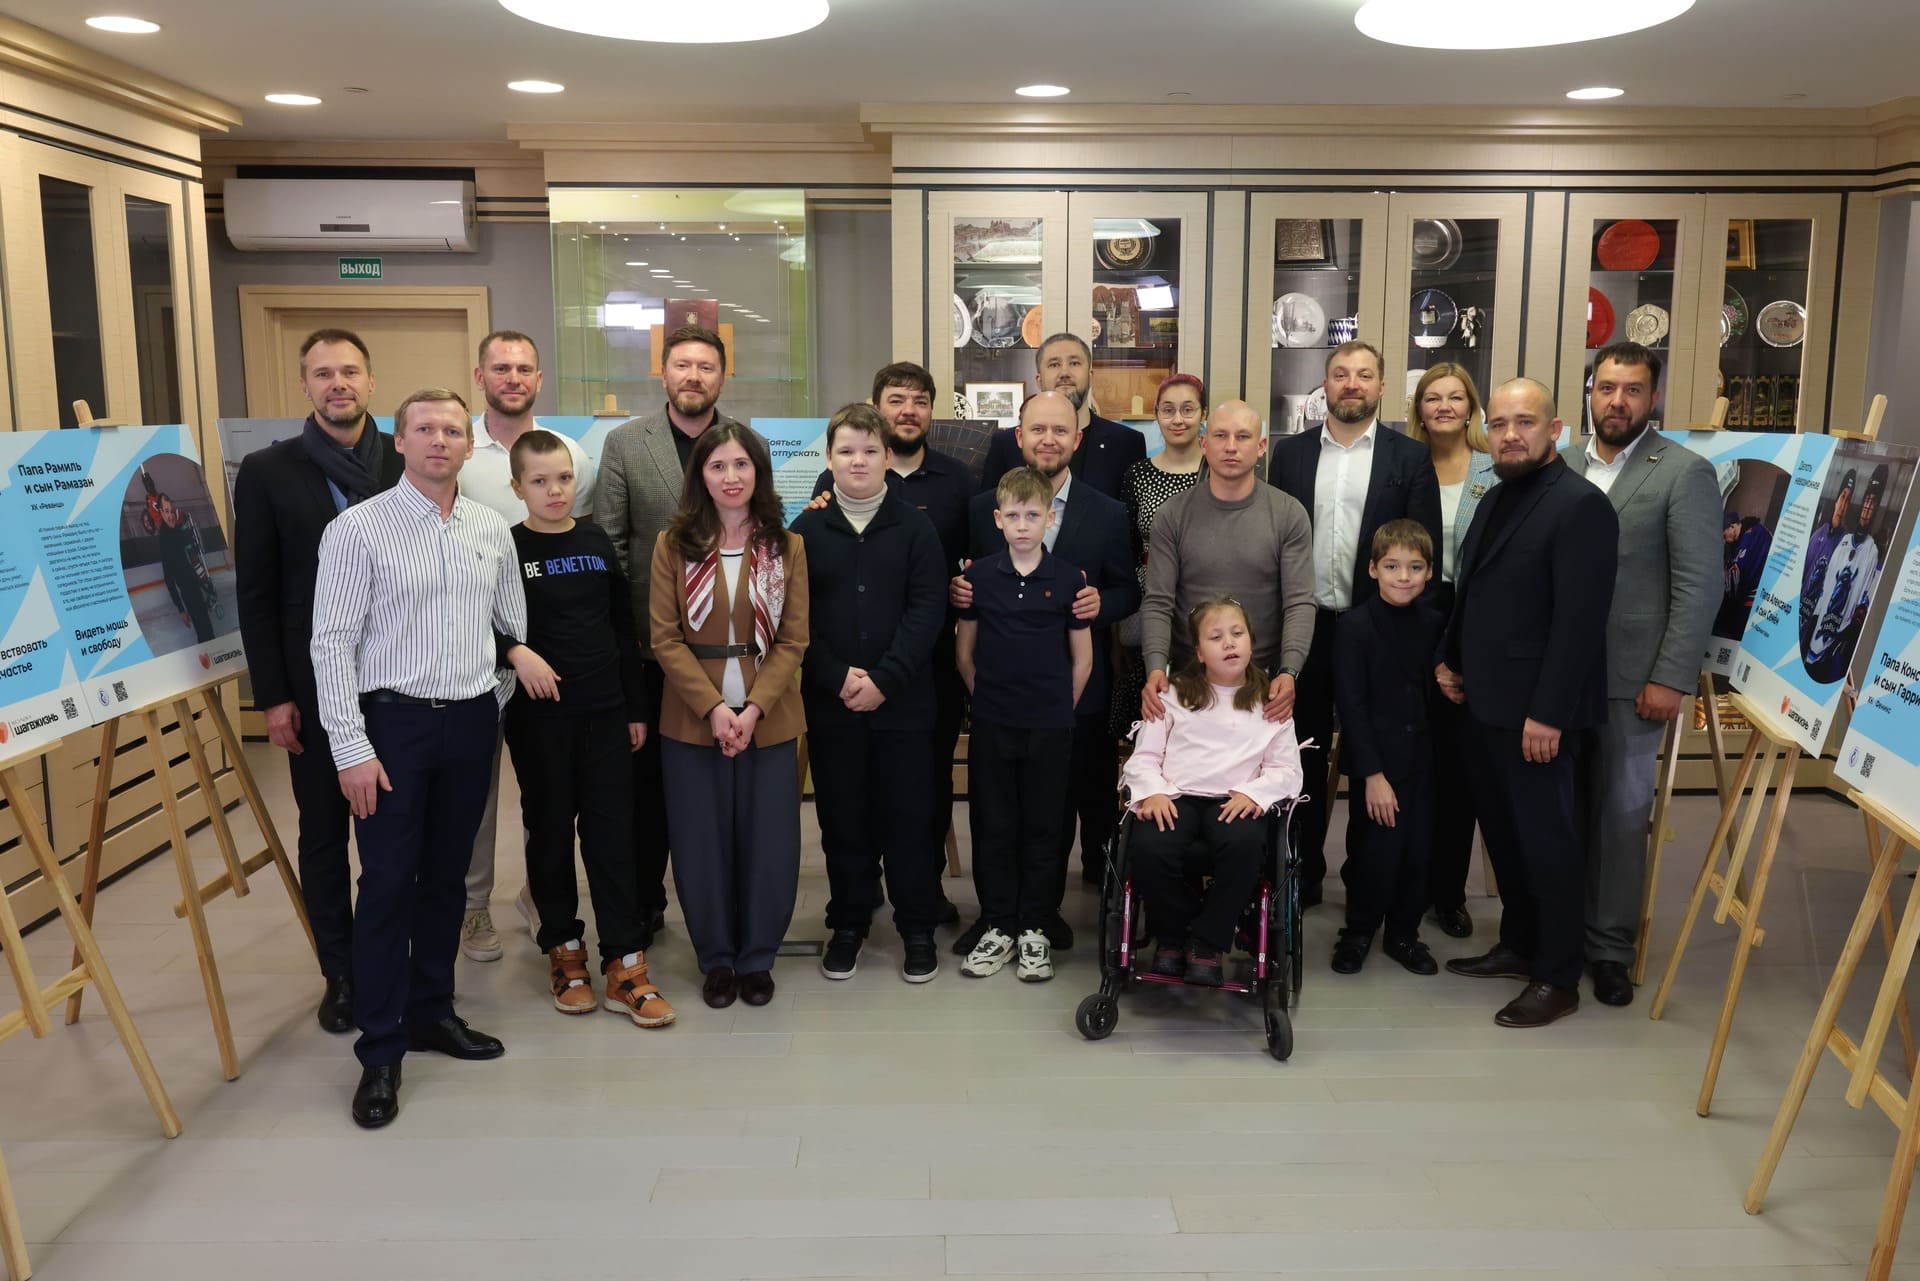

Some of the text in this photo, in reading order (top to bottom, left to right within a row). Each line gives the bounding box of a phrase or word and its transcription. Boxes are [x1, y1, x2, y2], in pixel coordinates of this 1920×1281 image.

[341, 263, 380, 276] ВЫХОД
[772, 450, 820, 458] отпускать
[18, 462, 82, 476] Папа Рамиль
[24, 478, 95, 494] и сын Рамазан
[524, 555, 607, 579] BE BENETTON
[75, 619, 129, 641] Видеть мощь
[80, 637, 121, 656] и свободу
[1880, 652, 1900, 672] Папа
[1873, 674, 1881, 686] и
[1880, 678, 1897, 694] сын
